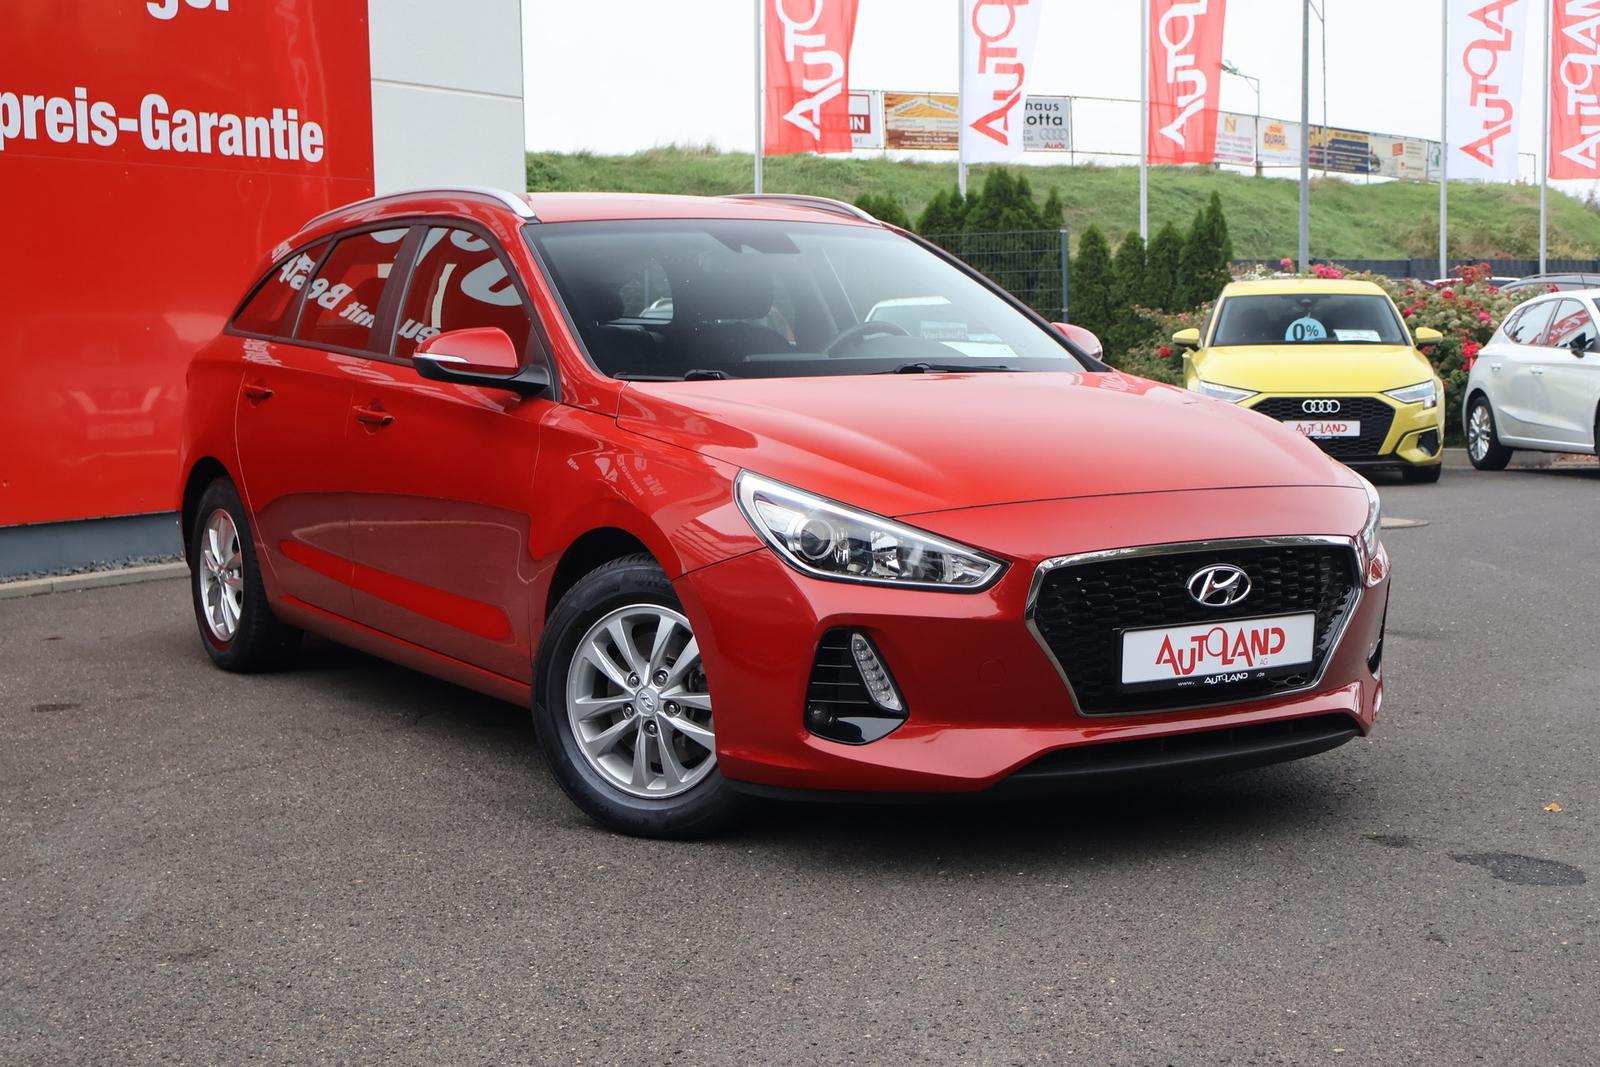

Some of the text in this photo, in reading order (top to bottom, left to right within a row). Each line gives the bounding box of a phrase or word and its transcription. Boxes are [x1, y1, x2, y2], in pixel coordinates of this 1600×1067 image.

[1024, 113, 1062, 126] otta
[1293, 323, 1318, 341] 0%
[1155, 626, 1286, 676] AUTOLAND
[1204, 672, 1248, 685] AUTOLAND
